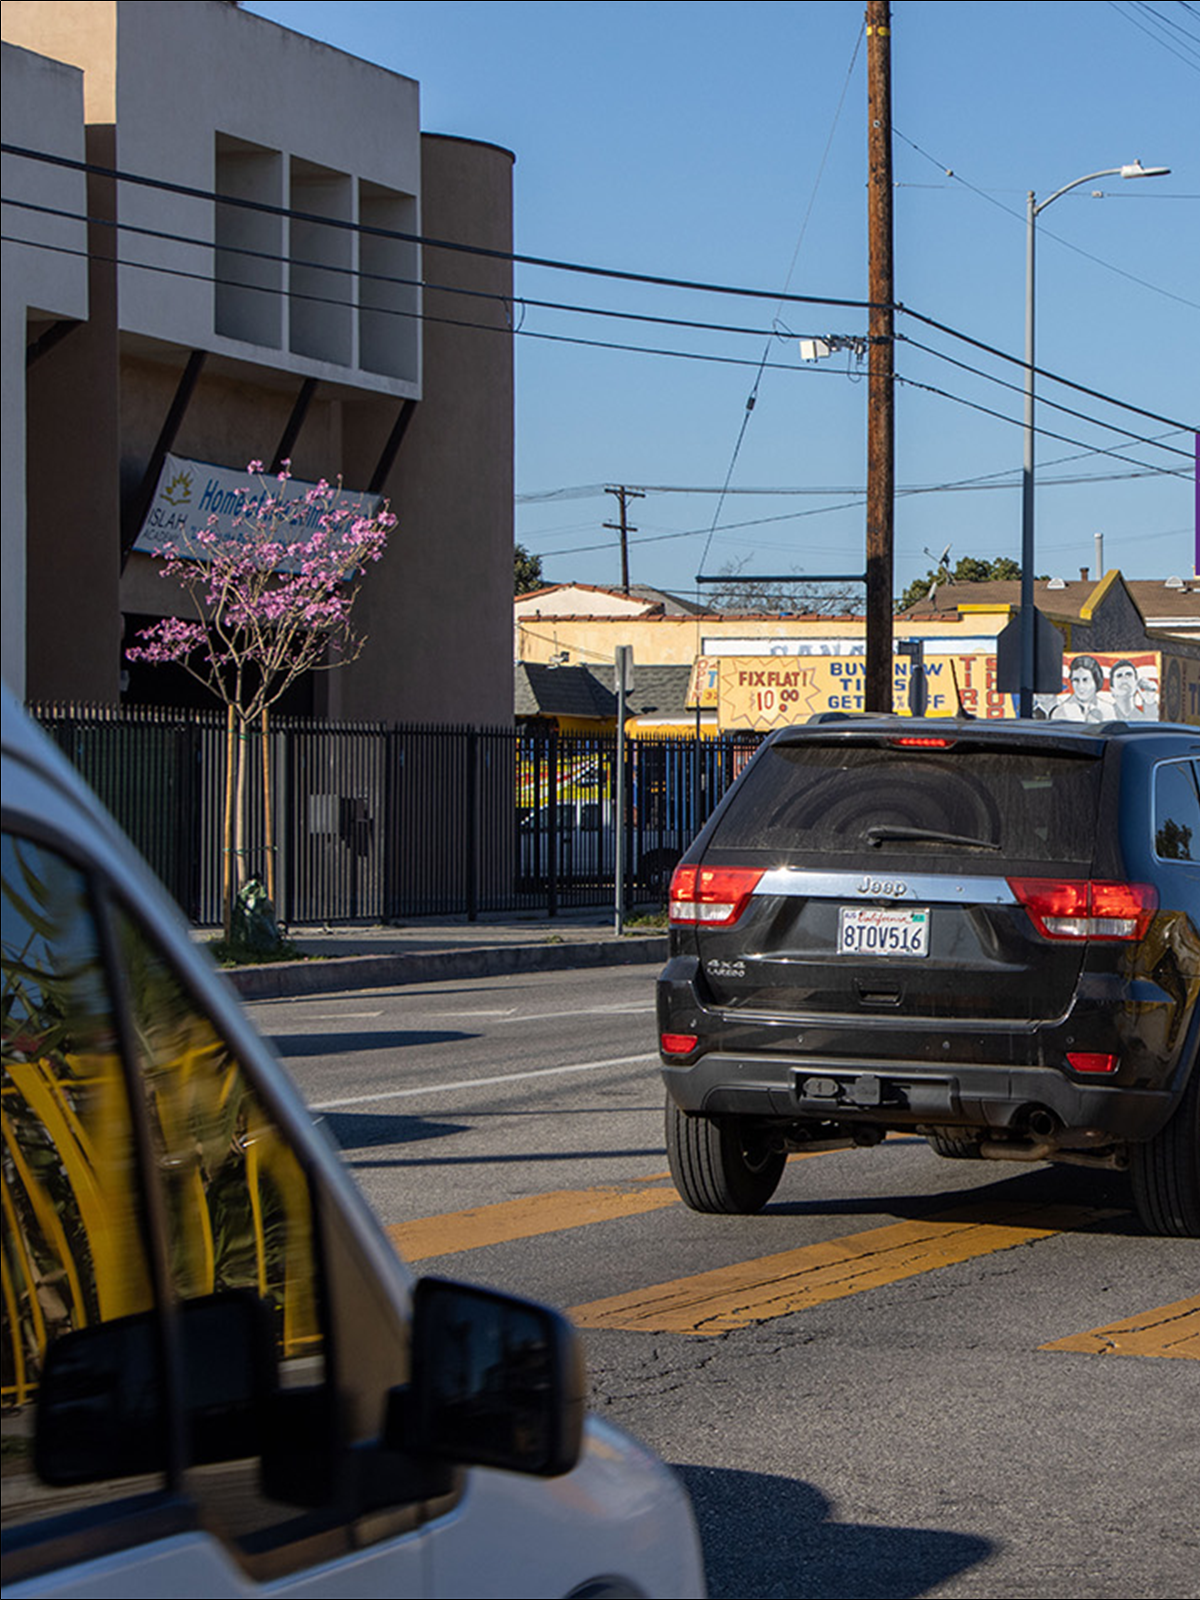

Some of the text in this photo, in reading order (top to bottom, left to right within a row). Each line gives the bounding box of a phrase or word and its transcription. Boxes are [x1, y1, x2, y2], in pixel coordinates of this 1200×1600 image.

[199, 479, 246, 516] Home
[895, 663, 943, 676] NW
[840, 678, 906, 692] TIS
[959, 656, 978, 715] TIR
[828, 695, 865, 709] GET
[857, 875, 908, 897] Jeep
[858, 910, 912, 926] California
